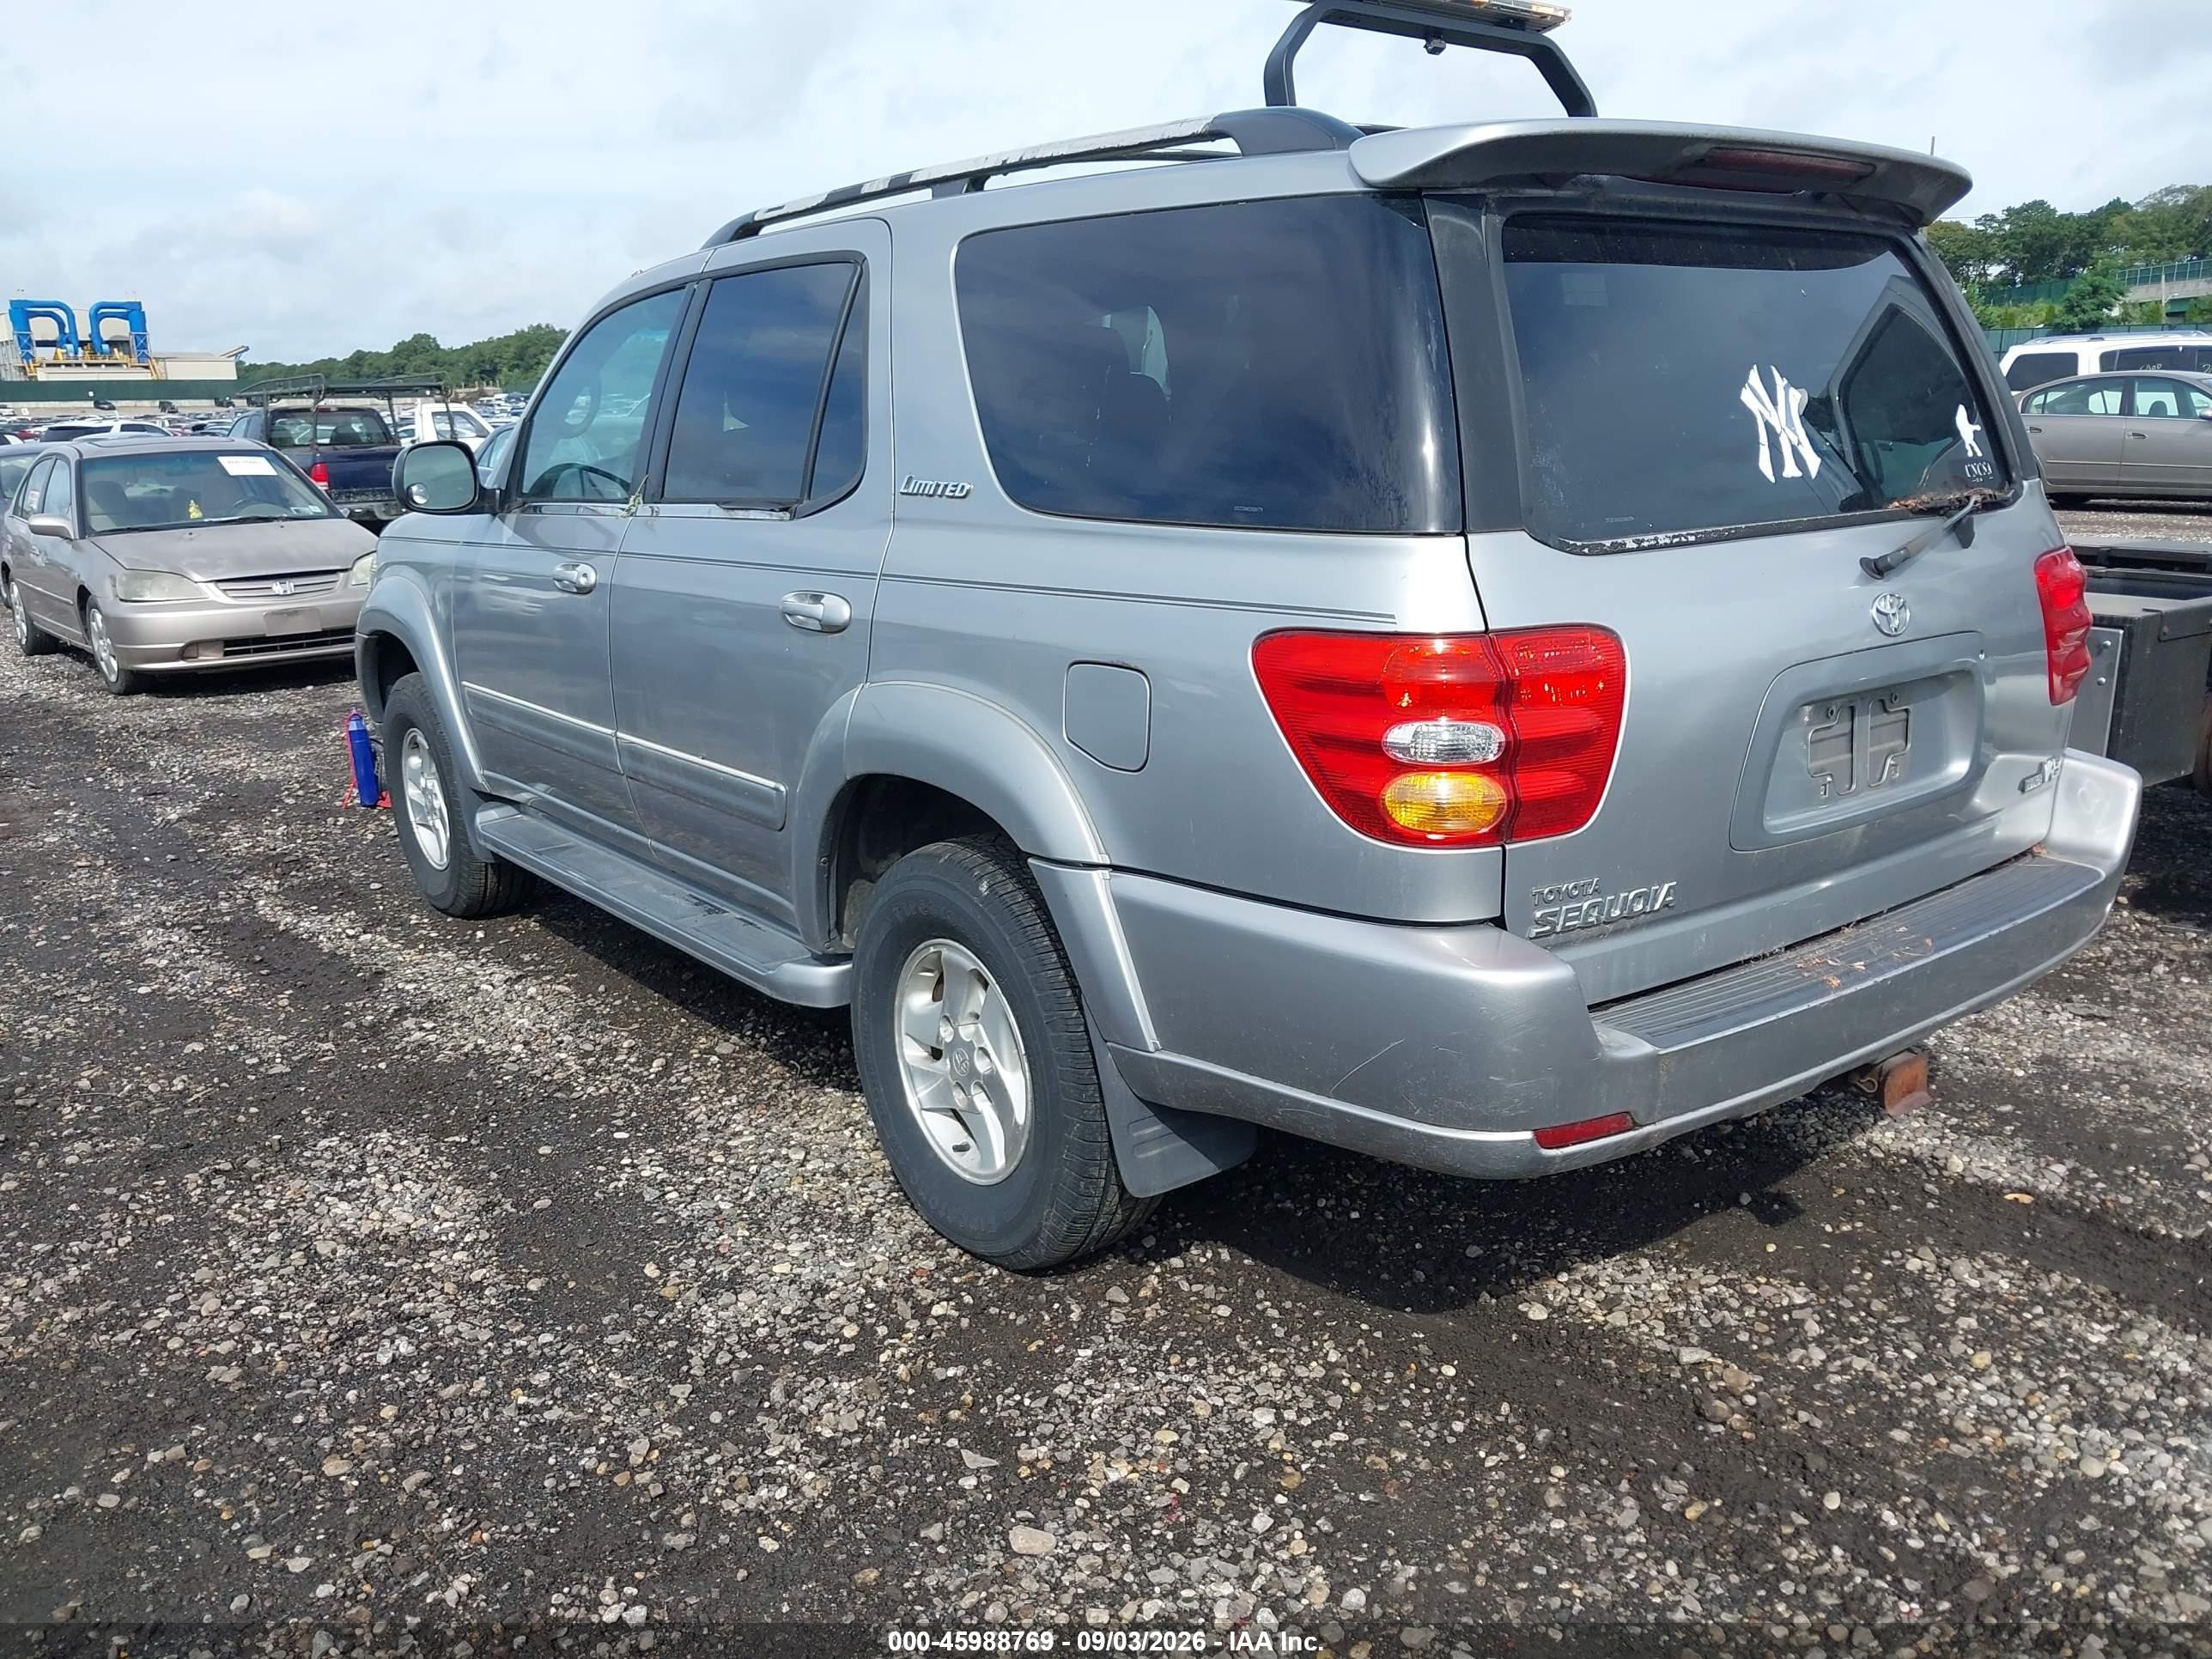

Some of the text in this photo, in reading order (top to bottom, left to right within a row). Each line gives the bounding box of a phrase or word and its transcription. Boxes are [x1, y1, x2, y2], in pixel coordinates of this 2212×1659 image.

[1741, 364, 1821, 483] NY
[1527, 881, 1676, 939] SEQUOIA
[1532, 878, 1601, 907] TOYOTA
